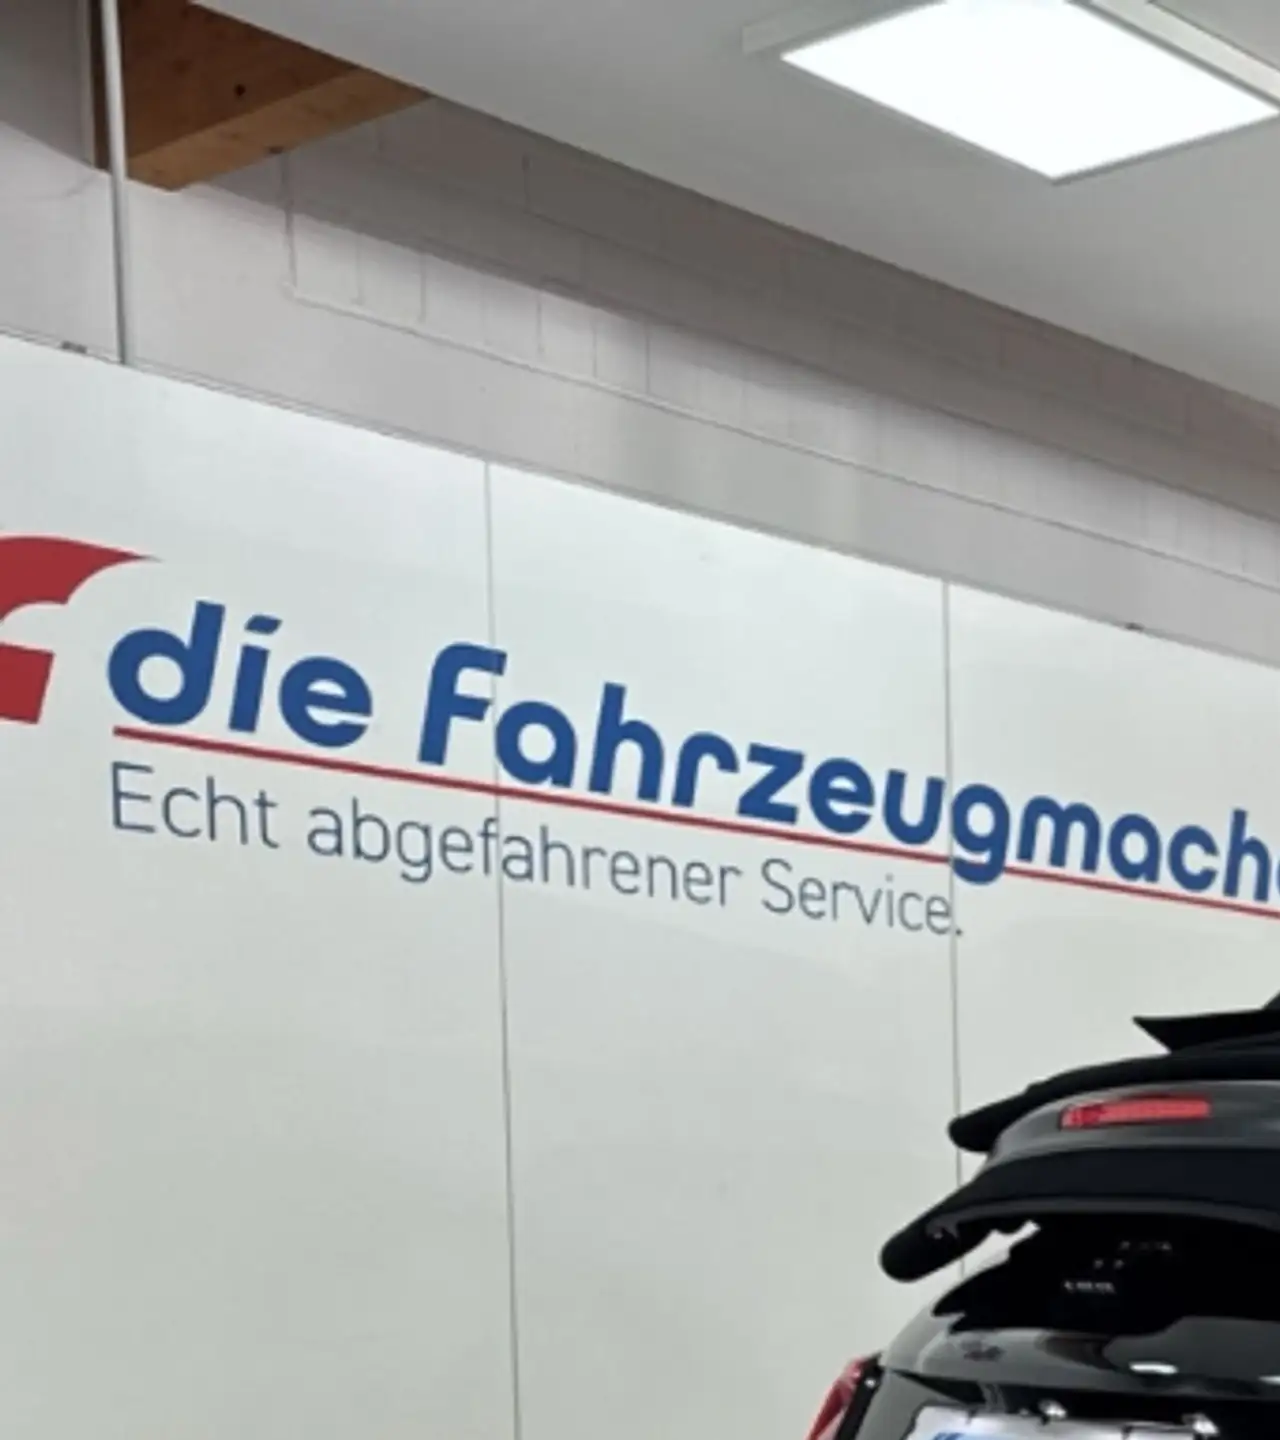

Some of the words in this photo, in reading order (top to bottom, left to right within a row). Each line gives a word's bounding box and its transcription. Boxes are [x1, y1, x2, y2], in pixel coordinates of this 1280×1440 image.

[109, 602, 371, 748] die
[110, 760, 281, 850] Echt
[306, 796, 743, 907] abgefahrener
[761, 857, 964, 937] Service.
